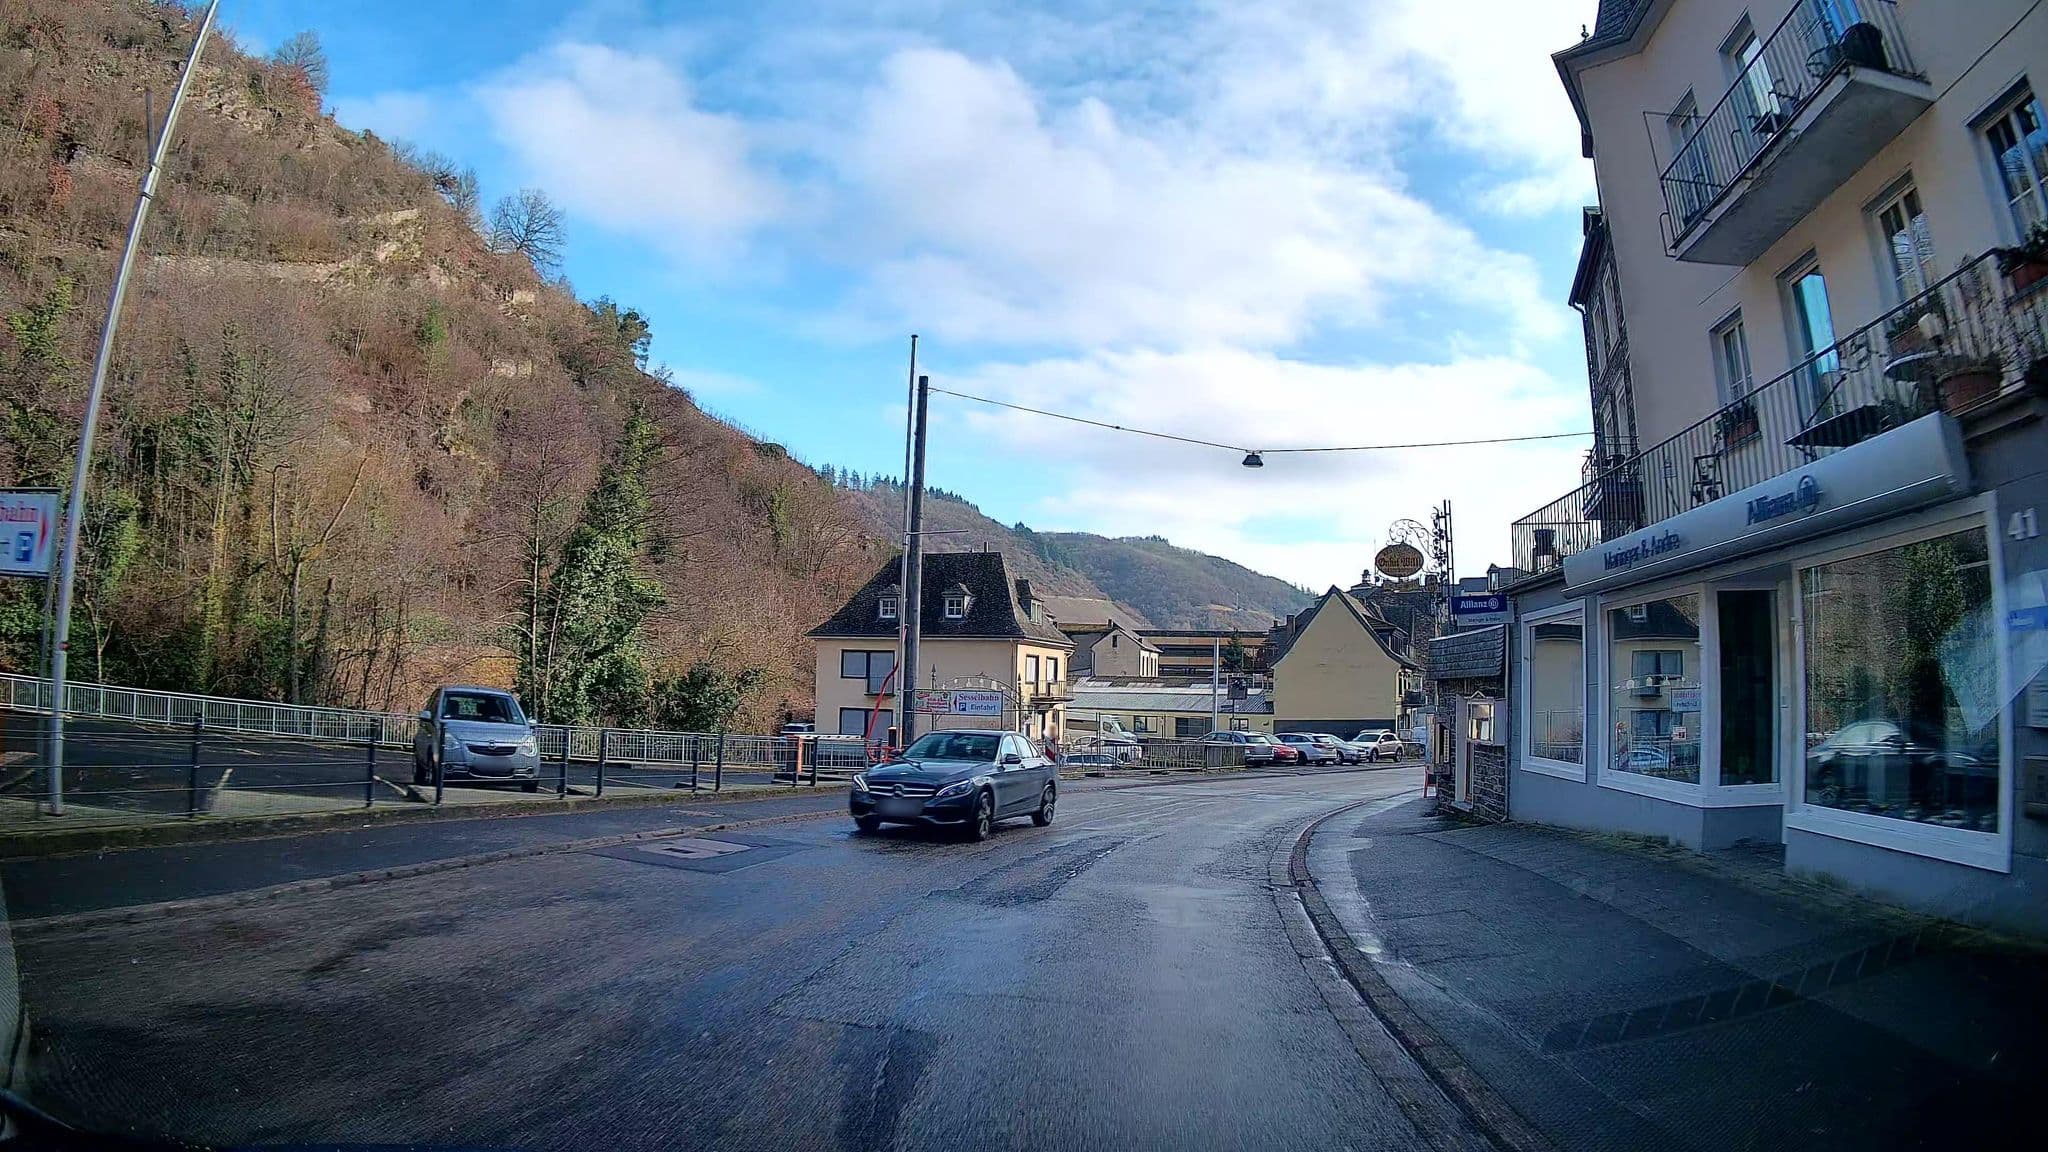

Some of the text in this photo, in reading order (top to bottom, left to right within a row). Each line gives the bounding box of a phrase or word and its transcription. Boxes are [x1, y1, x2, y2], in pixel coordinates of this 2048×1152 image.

[2007, 507, 2041, 540] 41
[1641, 540, 1653, 559] &
[1460, 600, 1488, 609] Allianz
[959, 693, 999, 701] Sesselbahn
[970, 703, 996, 711] Einfahrt
